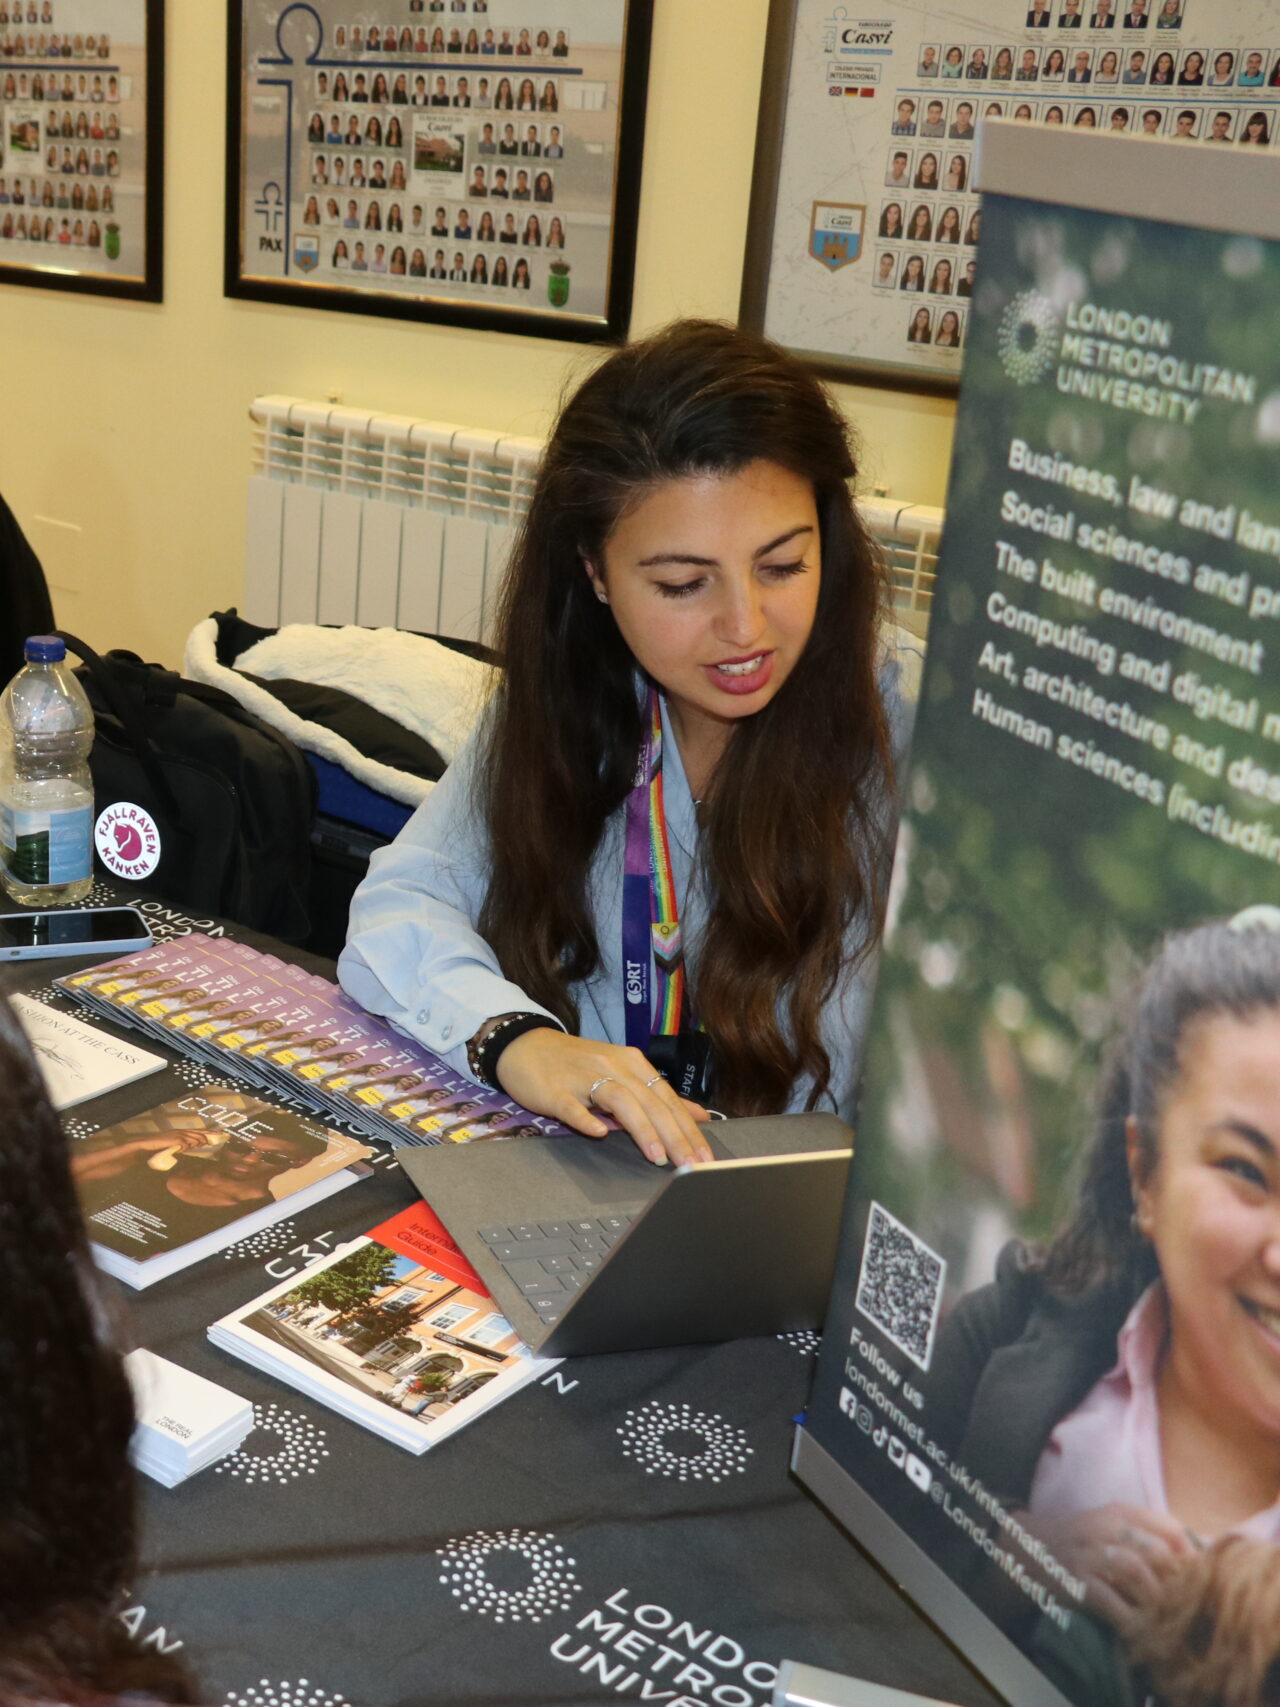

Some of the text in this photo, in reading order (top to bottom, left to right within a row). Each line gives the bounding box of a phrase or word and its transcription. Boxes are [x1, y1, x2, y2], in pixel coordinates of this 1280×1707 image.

[829, 72, 878, 81] INTERNACIONAL
[841, 28, 893, 44] Casvi
[259, 236, 282, 252] PAX
[1066, 301, 1171, 347] LONDON
[1056, 364, 1201, 424] UNIVERSITY
[1061, 333, 1258, 405] METROPOLITAN
[1008, 438, 1124, 507] Business,
[1128, 473, 1178, 519] law
[1179, 499, 1236, 540] and
[1000, 489, 1075, 541] Social
[1076, 522, 1191, 585] sciences
[1193, 563, 1251, 606] and
[995, 540, 1265, 675] The built environment
[986, 591, 1117, 676] Computing
[1120, 652, 1172, 693] and
[1172, 671, 1258, 732] digital
[972, 687, 1054, 750] Human
[1056, 734, 1166, 805] sciences
[978, 641, 1019, 687] Art,
[1023, 665, 1171, 750] architecture
[1172, 734, 1225, 777] and
[80, 1031, 105, 1049] THE
[103, 1046, 140, 1065] CASS
[177, 1097, 274, 1139] CODE
[397, 1231, 437, 1256] Guide
[849, 1326, 925, 1410] Follow us
[155, 1419, 189, 1439] LONDON
[844, 1356, 1086, 1604] londonmet.ac.uk/international
[930, 1481, 1071, 1632] @LondonMetUni
[576, 1610, 756, 1707] METRO
[604, 1588, 778, 1690] LONDO
